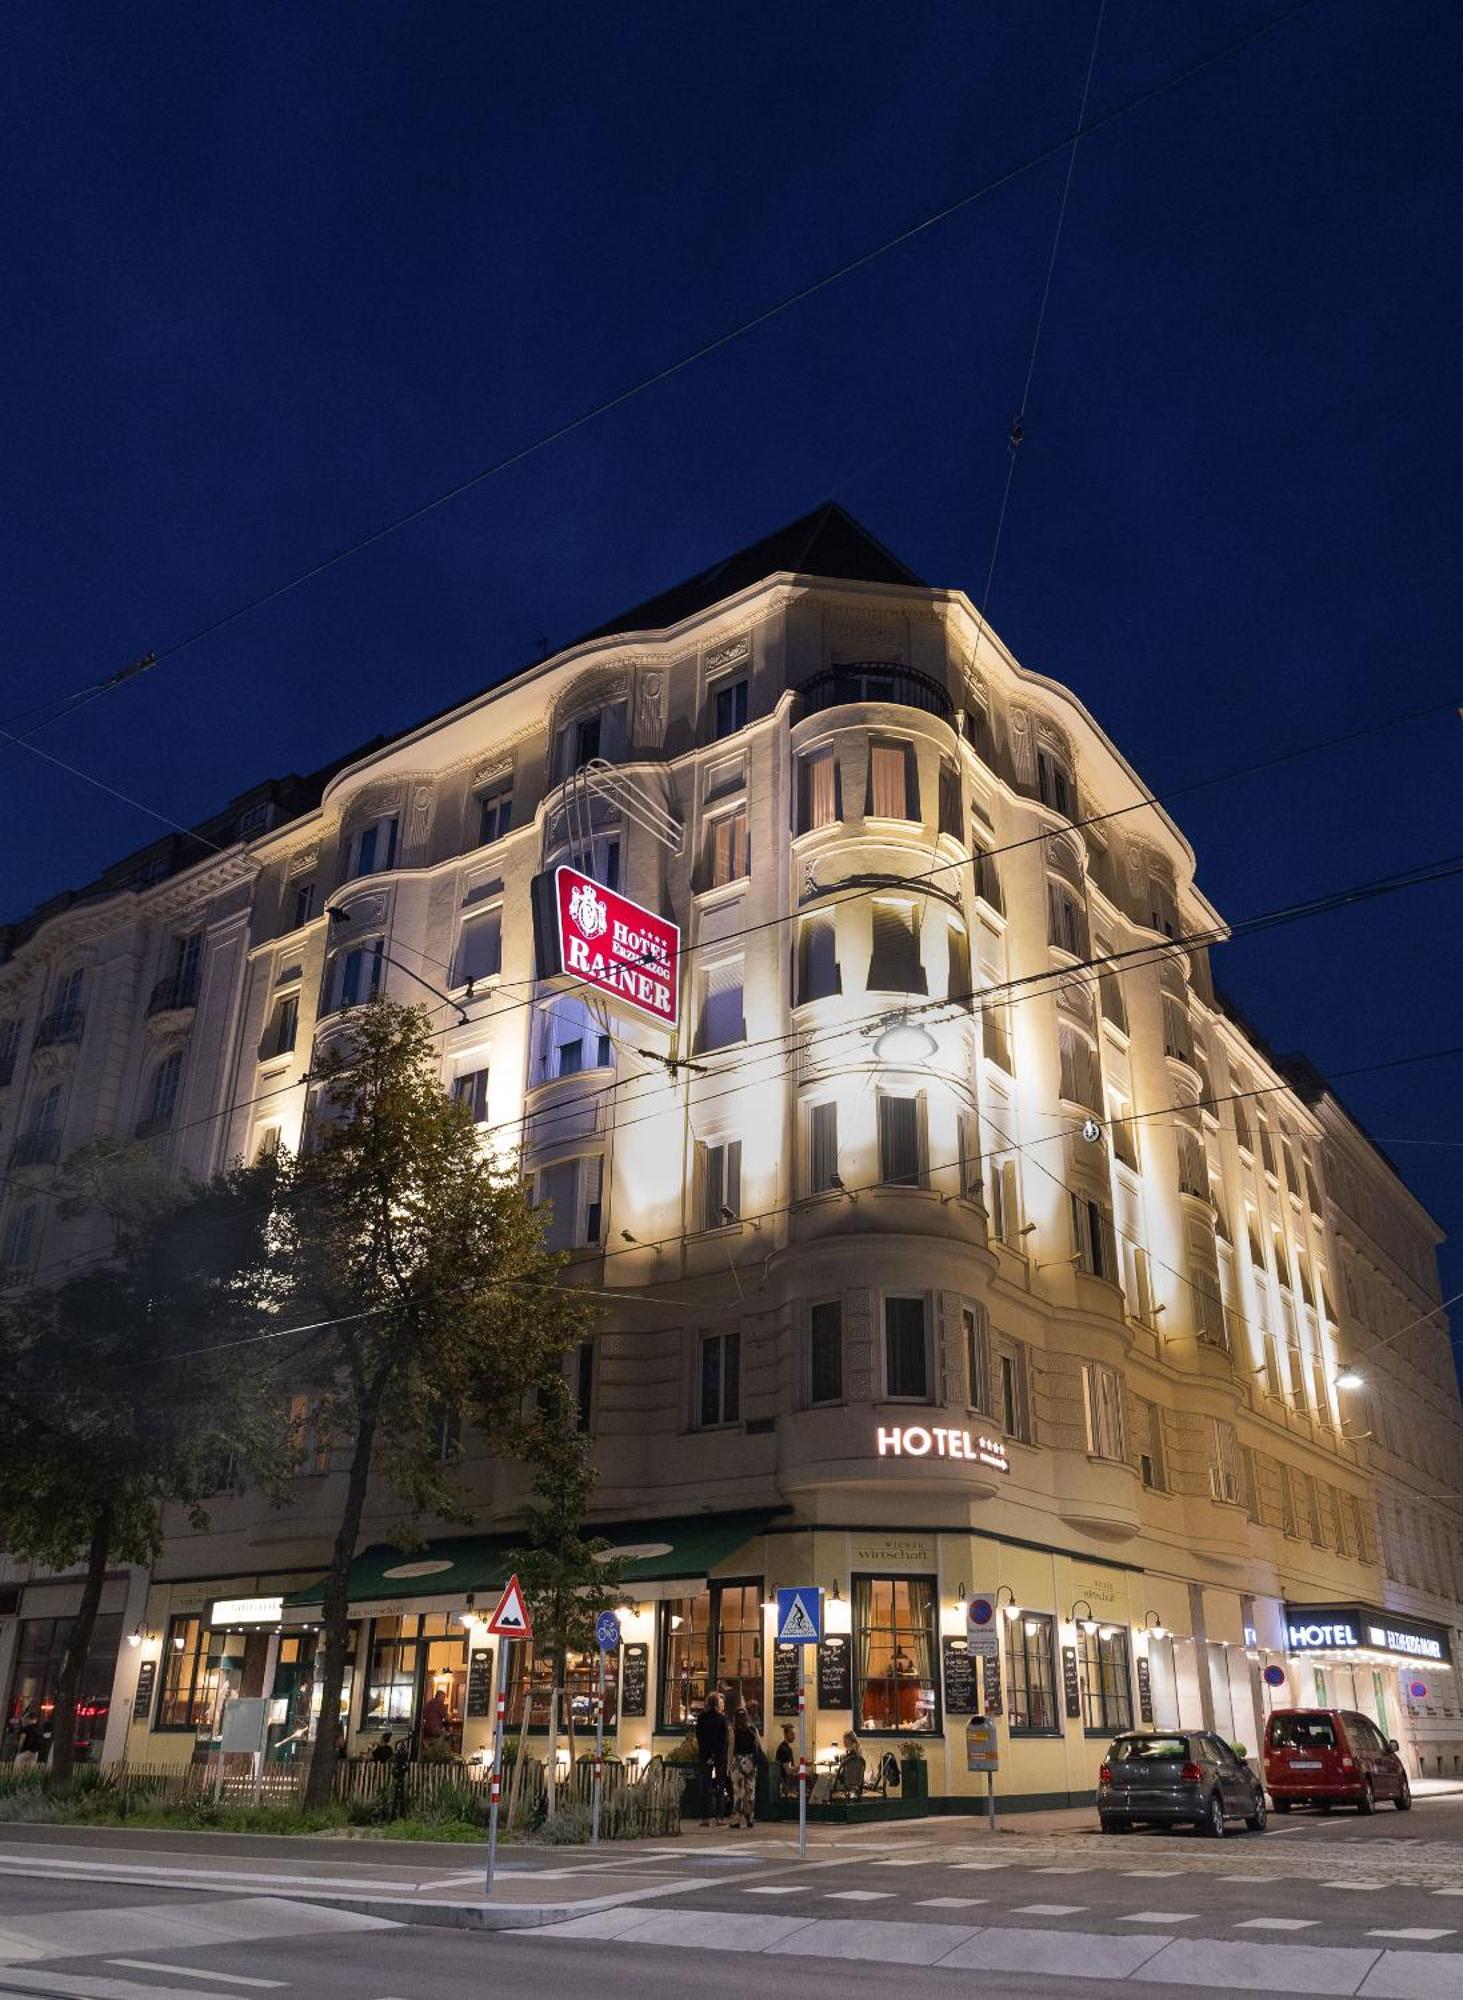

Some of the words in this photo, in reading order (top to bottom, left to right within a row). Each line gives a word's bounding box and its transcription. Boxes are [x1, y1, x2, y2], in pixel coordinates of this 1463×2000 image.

[612, 919, 671, 968] HOTEL
[567, 934, 672, 1013] RAINER
[877, 1426, 977, 1460] HOTEL
[1289, 1625, 1358, 1647] HOTEL
